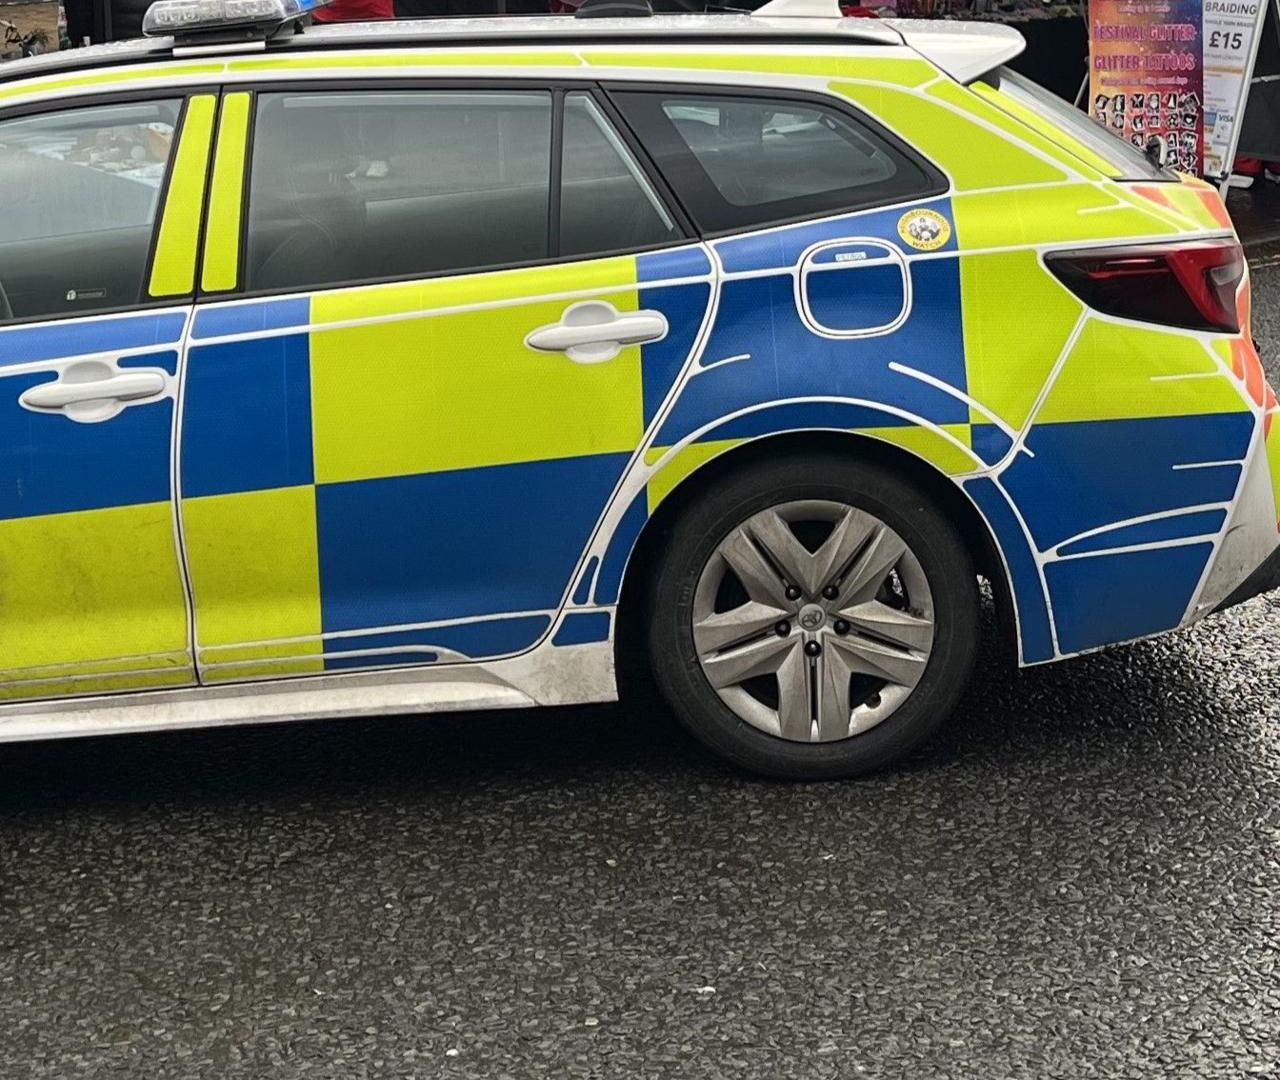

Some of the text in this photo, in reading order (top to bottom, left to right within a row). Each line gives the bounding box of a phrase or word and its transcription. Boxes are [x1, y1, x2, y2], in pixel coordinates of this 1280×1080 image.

[1204, 1, 1257, 16] BRAIDING
[1094, 24, 1143, 41] FESTIVAL
[1150, 23, 1197, 41] GLITTER
[1208, 30, 1243, 50] £15
[1094, 51, 1196, 71] GLITTER TATTOOS
[912, 240, 942, 249] WATCH
